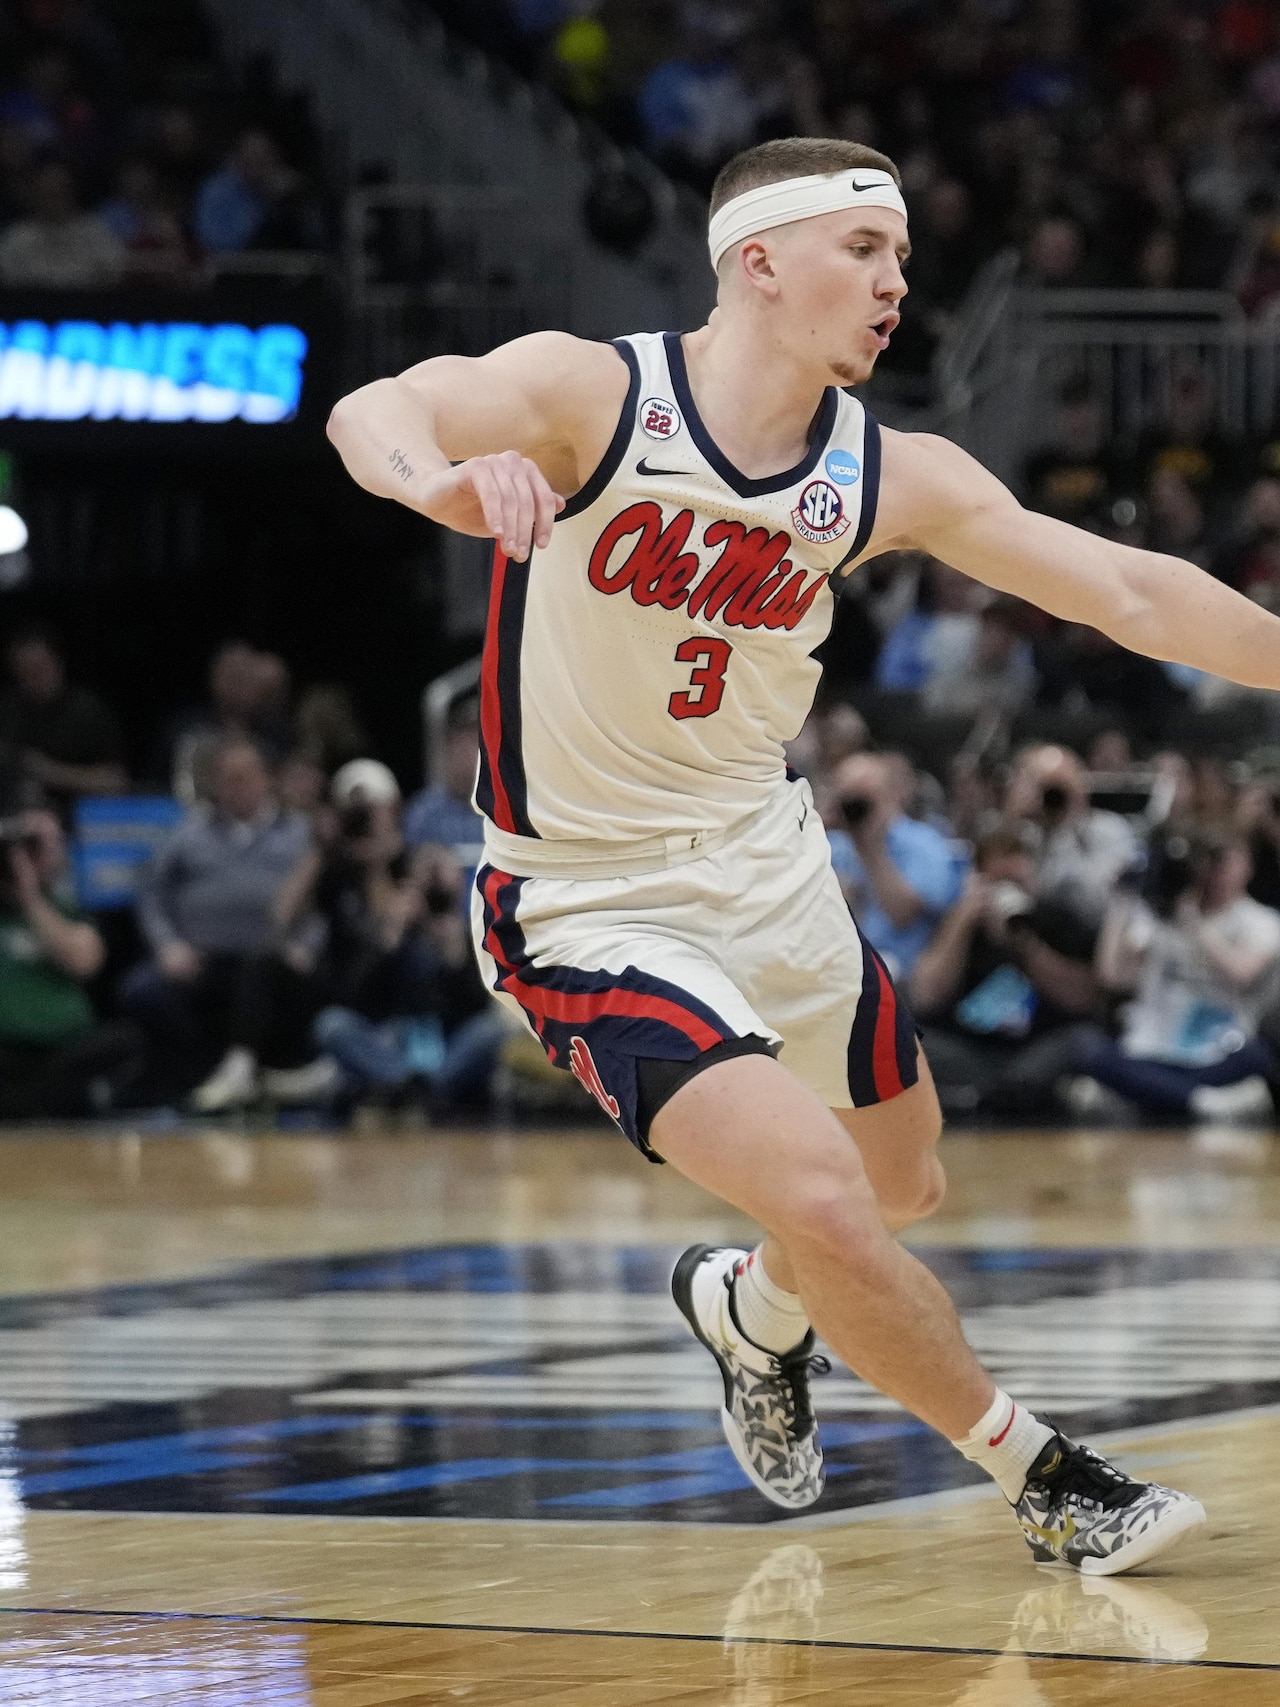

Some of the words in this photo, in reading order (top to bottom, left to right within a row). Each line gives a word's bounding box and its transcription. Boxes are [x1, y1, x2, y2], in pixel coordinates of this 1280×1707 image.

[645, 410, 672, 435] 22
[830, 463, 858, 477] NCAA
[802, 483, 839, 528] SEC
[795, 520, 840, 542] GRADUATE
[588, 501, 699, 610] Ole
[688, 519, 830, 631] Miss
[667, 636, 734, 721] 3
